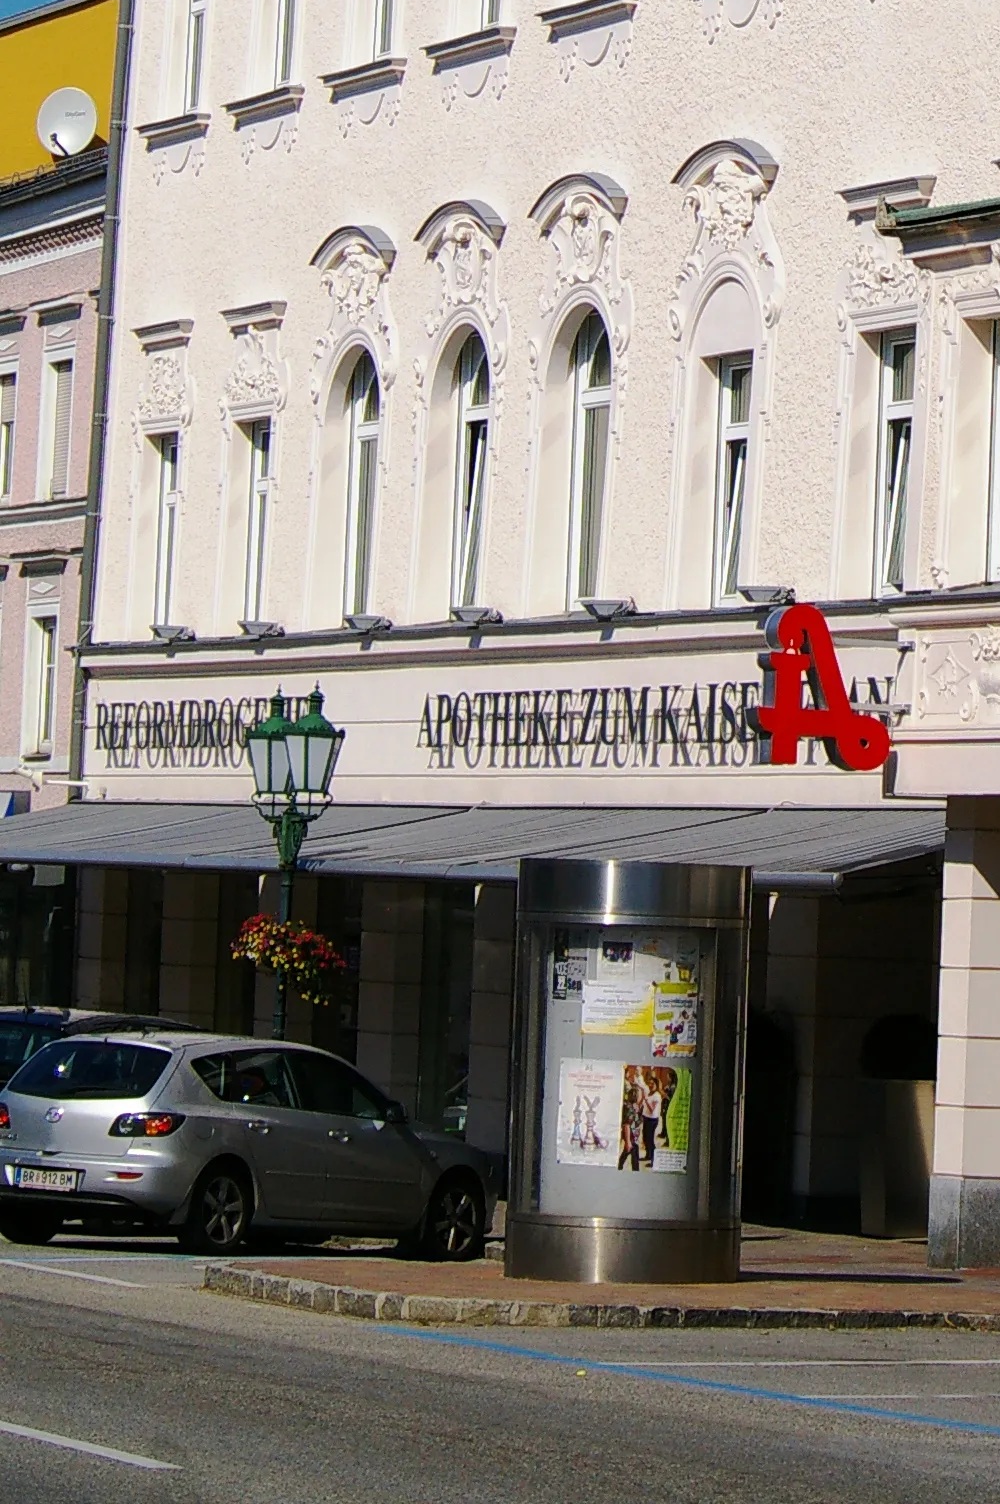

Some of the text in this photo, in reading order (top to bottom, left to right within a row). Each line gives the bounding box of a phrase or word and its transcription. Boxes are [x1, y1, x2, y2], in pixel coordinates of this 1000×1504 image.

[417, 689, 573, 748] APOTHEKE
[579, 686, 650, 745] ZUM
[659, 682, 760, 744] KAISE
